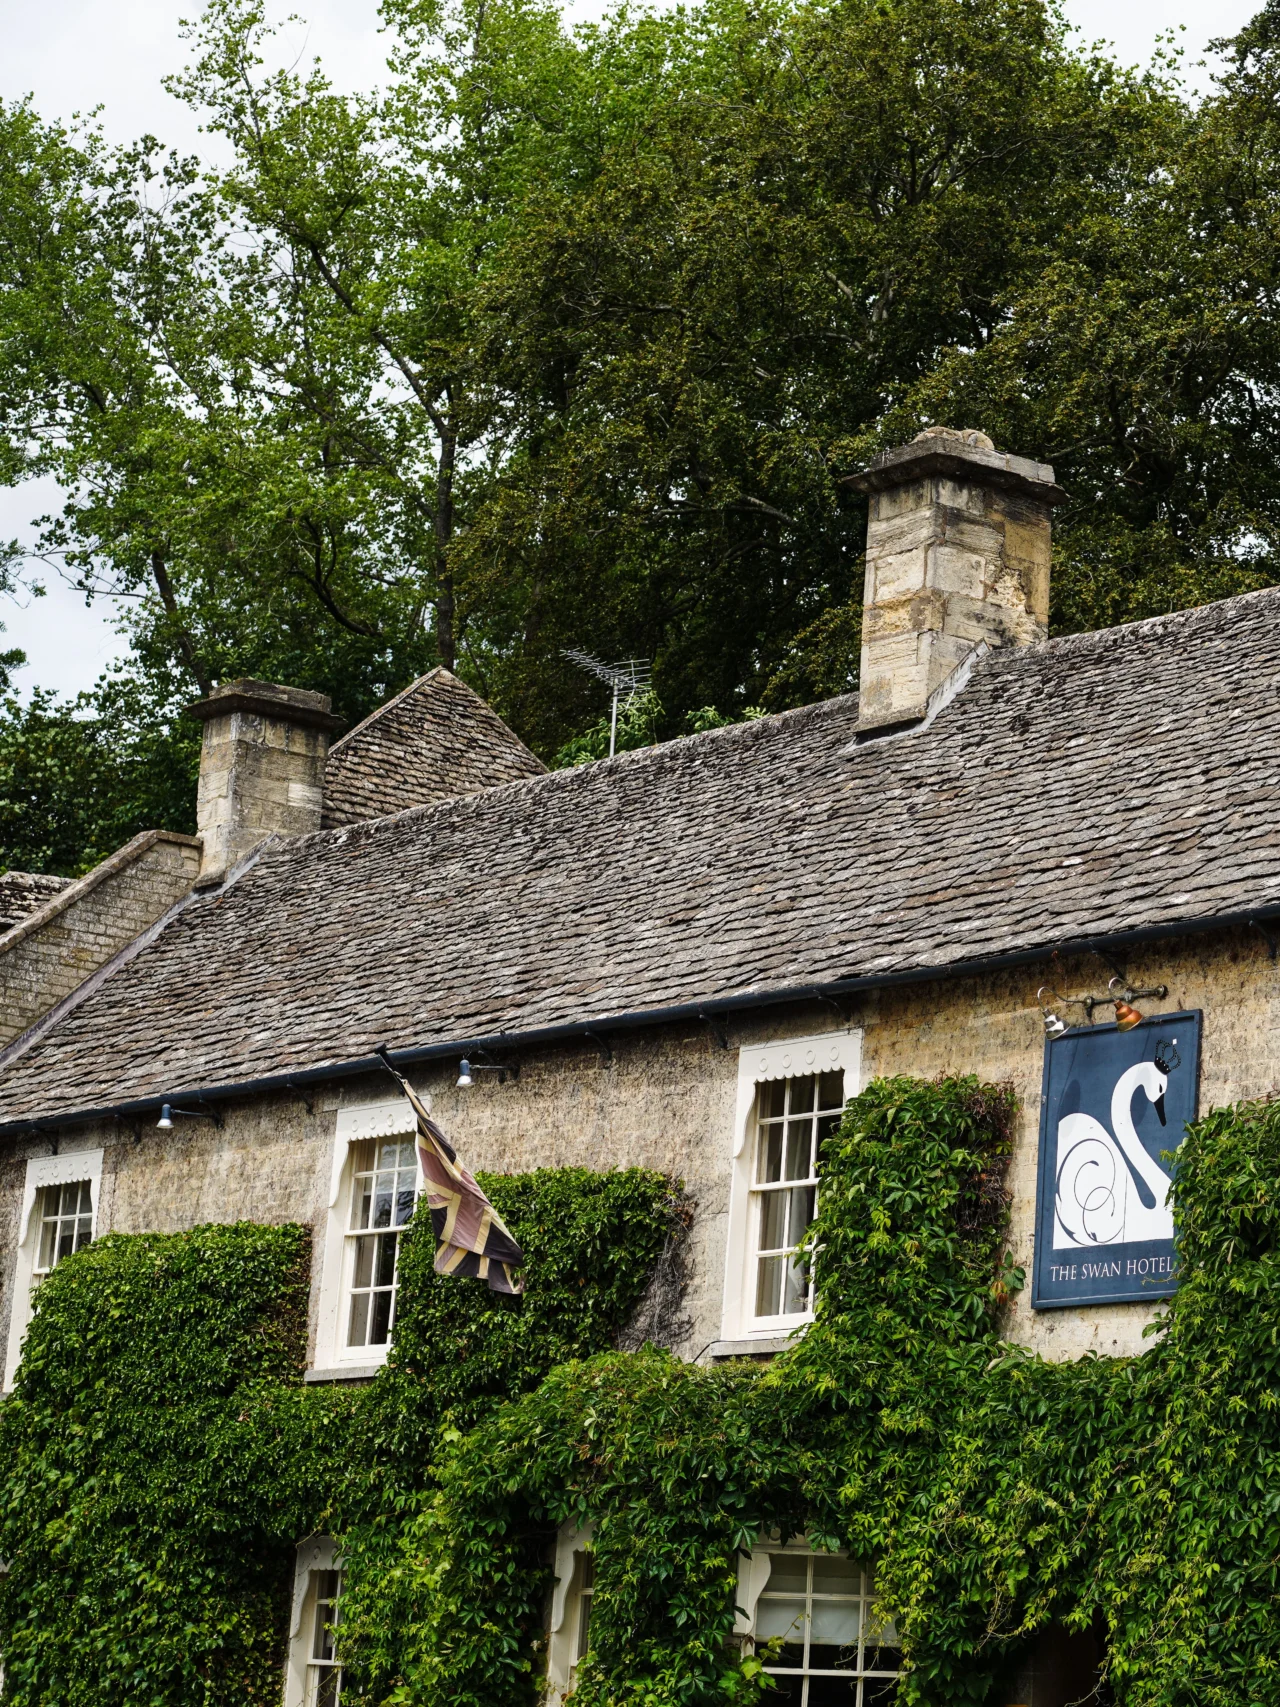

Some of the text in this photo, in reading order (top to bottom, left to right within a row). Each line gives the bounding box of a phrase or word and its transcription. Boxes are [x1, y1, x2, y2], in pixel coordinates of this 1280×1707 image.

[1050, 1256, 1173, 1281] THE SWAN HOTEL
